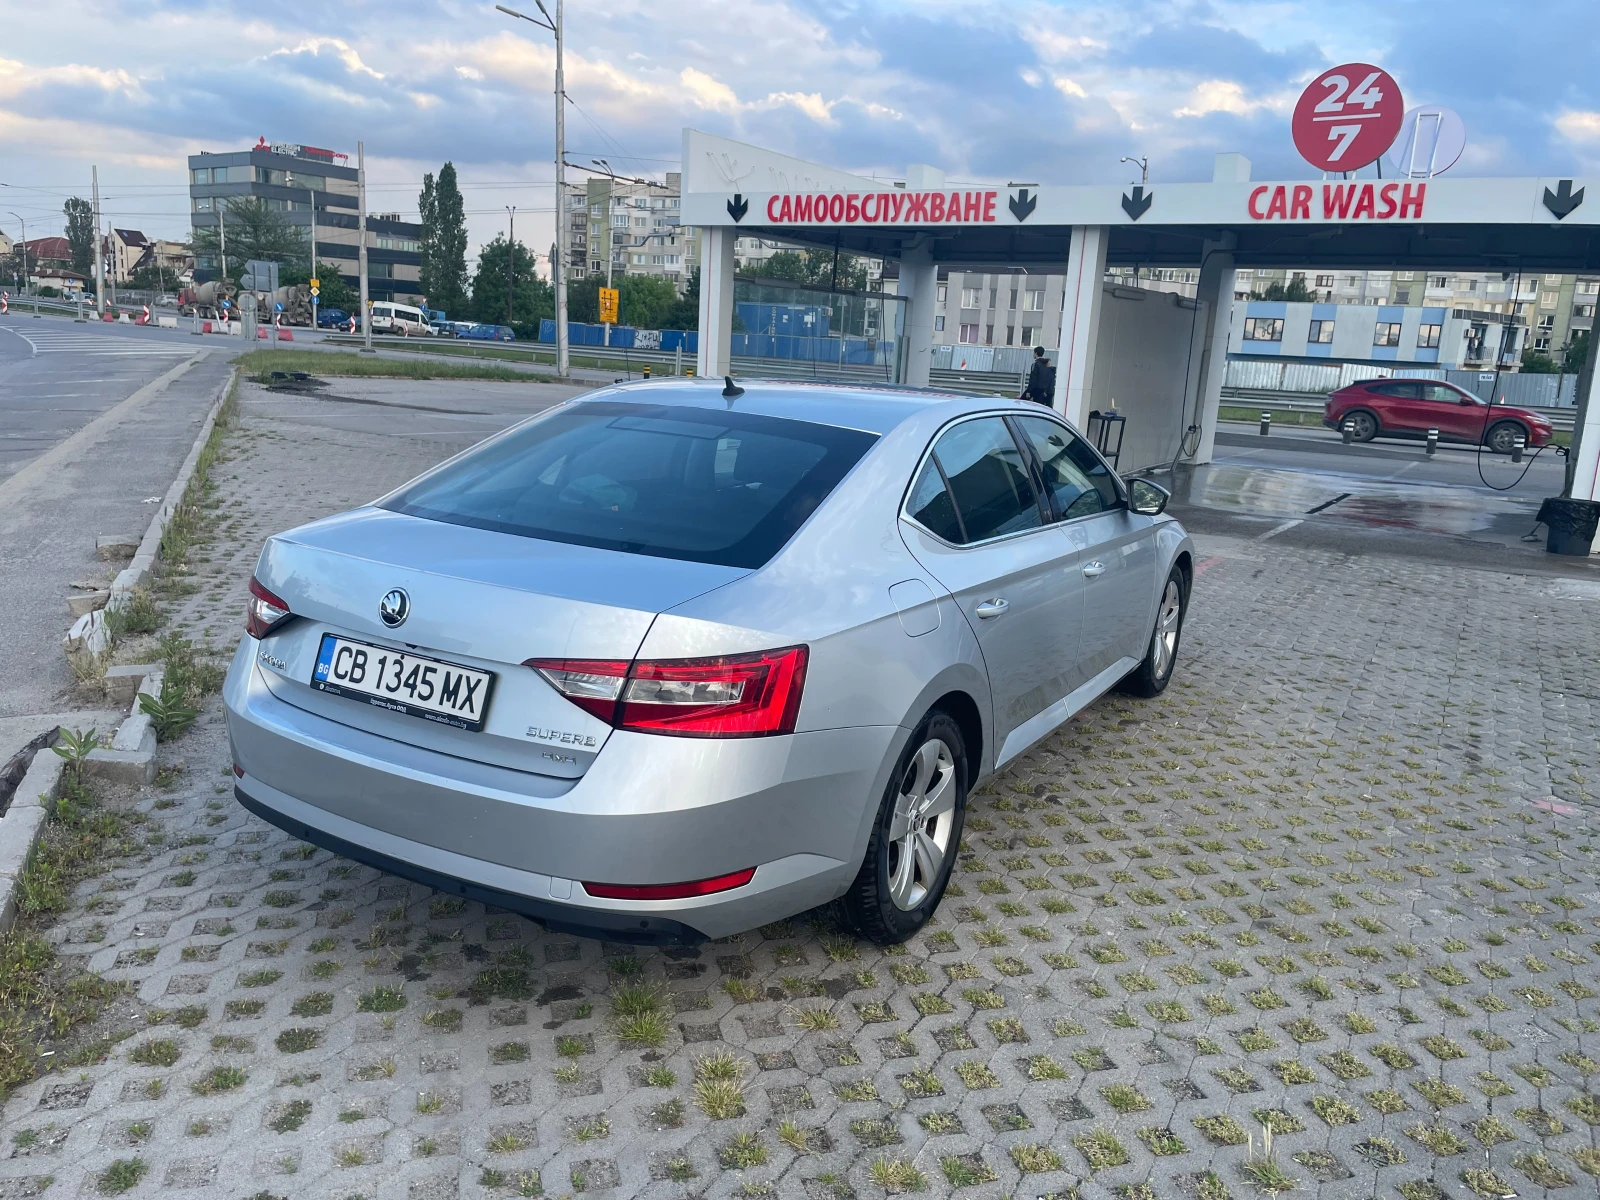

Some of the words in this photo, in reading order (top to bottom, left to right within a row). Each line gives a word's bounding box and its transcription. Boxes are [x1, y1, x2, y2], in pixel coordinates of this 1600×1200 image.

[1314, 72, 1383, 113] 24
[1326, 124, 1362, 162] 7
[767, 191, 998, 223] САМООБСЛУЖВАНЕ
[1248, 184, 1313, 220] CAR
[1322, 183, 1427, 220] WASH
[317, 663, 329, 675] BG
[333, 646, 368, 684] CB
[376, 655, 438, 702] 1345
[438, 671, 483, 714] MX
[526, 725, 597, 747] SUPERB
